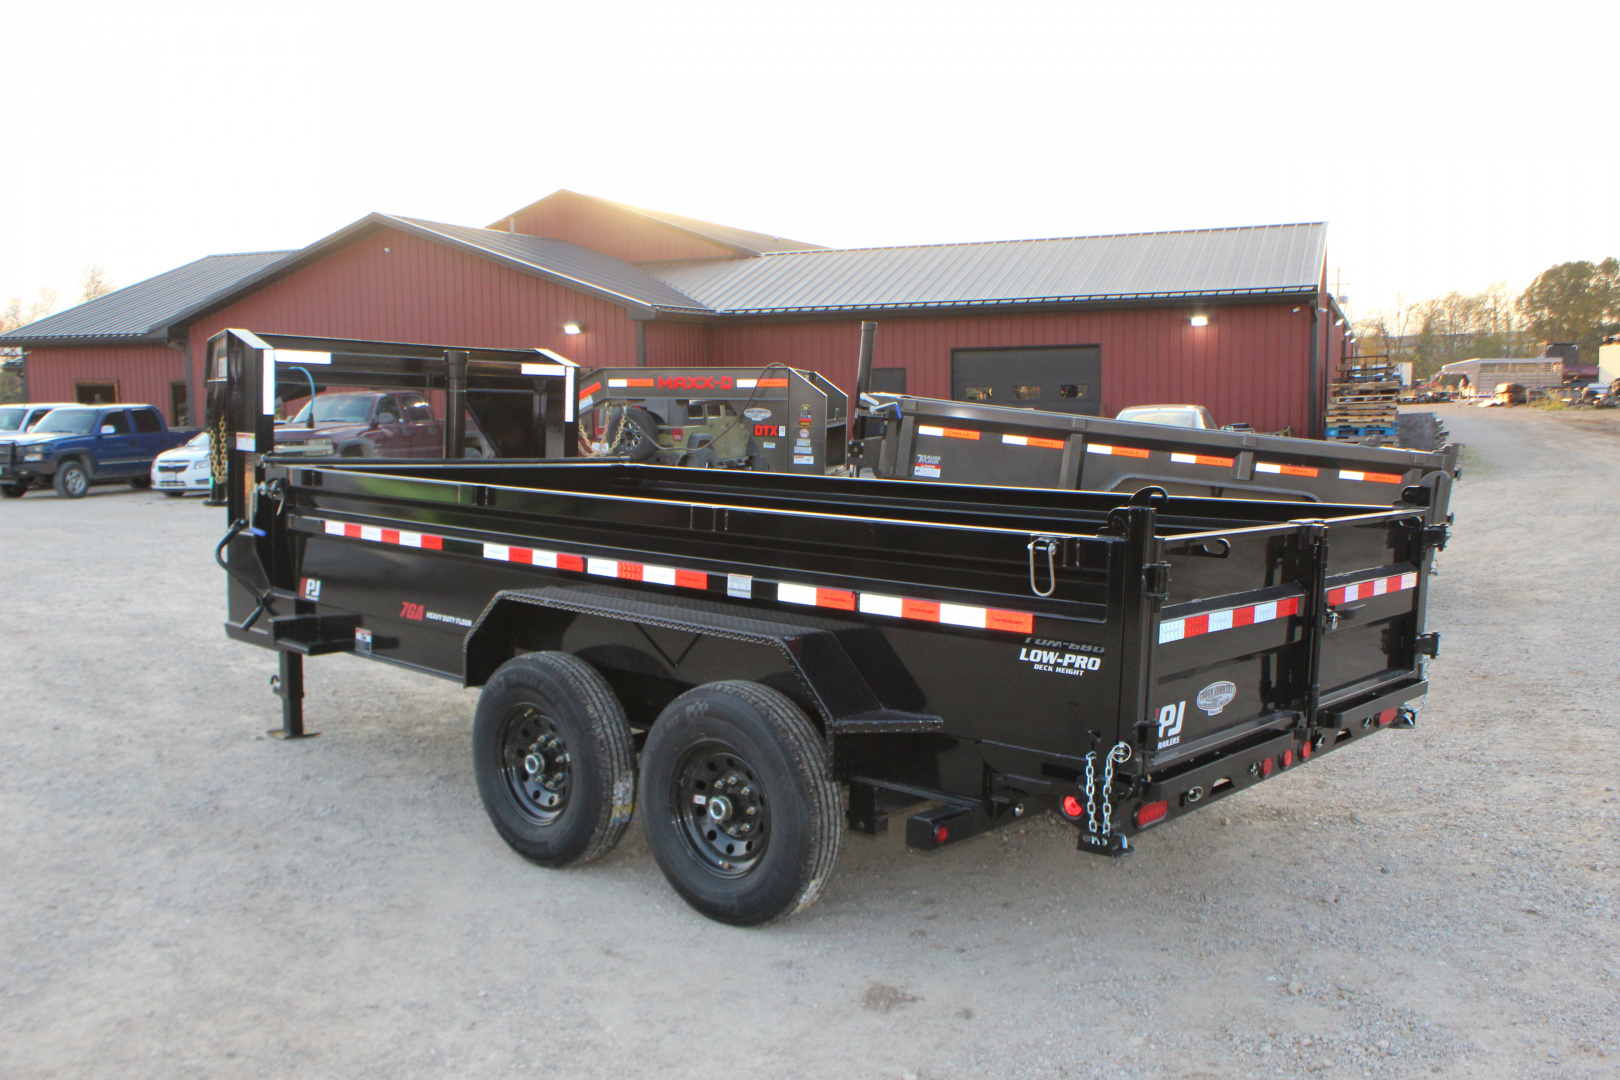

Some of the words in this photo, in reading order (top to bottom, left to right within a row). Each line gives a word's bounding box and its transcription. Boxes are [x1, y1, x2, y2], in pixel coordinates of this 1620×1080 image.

[657, 376, 734, 390] MAXX-D
[754, 424, 779, 436] DTX
[305, 578, 321, 597] PJ
[400, 601, 425, 622] 7GA
[1018, 648, 1102, 671] LOW-PRO
[1033, 663, 1054, 672] DECK
[1055, 666, 1085, 677] HEIGHT
[1158, 700, 1187, 738] PJ
[1157, 735, 1180, 750] RAILERS
